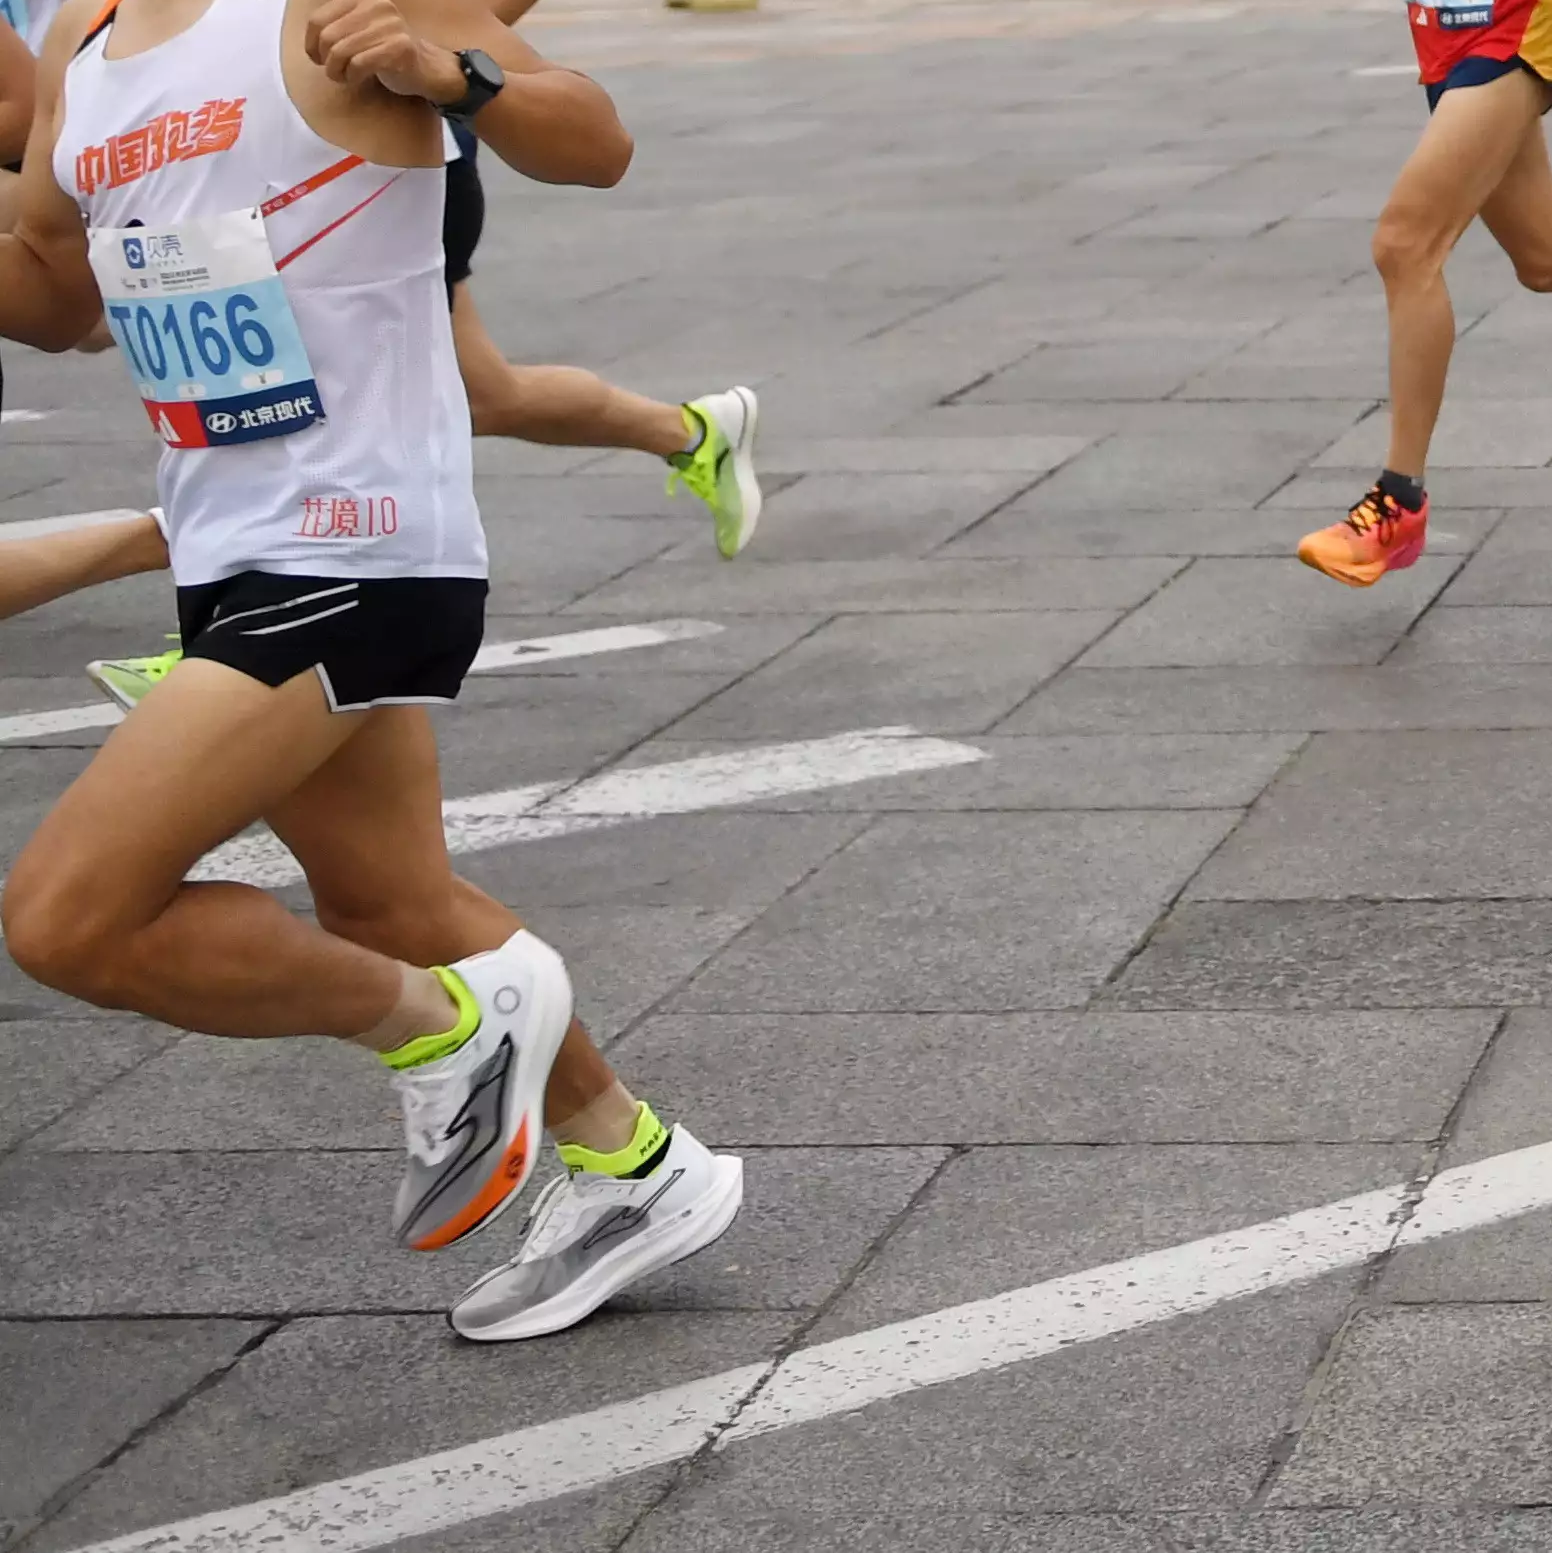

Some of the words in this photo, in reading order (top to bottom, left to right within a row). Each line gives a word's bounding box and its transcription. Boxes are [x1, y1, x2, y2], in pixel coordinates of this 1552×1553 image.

[75, 96, 247, 196] 中国跑者
[146, 233, 183, 258] 贝壳
[109, 293, 275, 381] T0166
[237, 396, 316, 430] 北京现代
